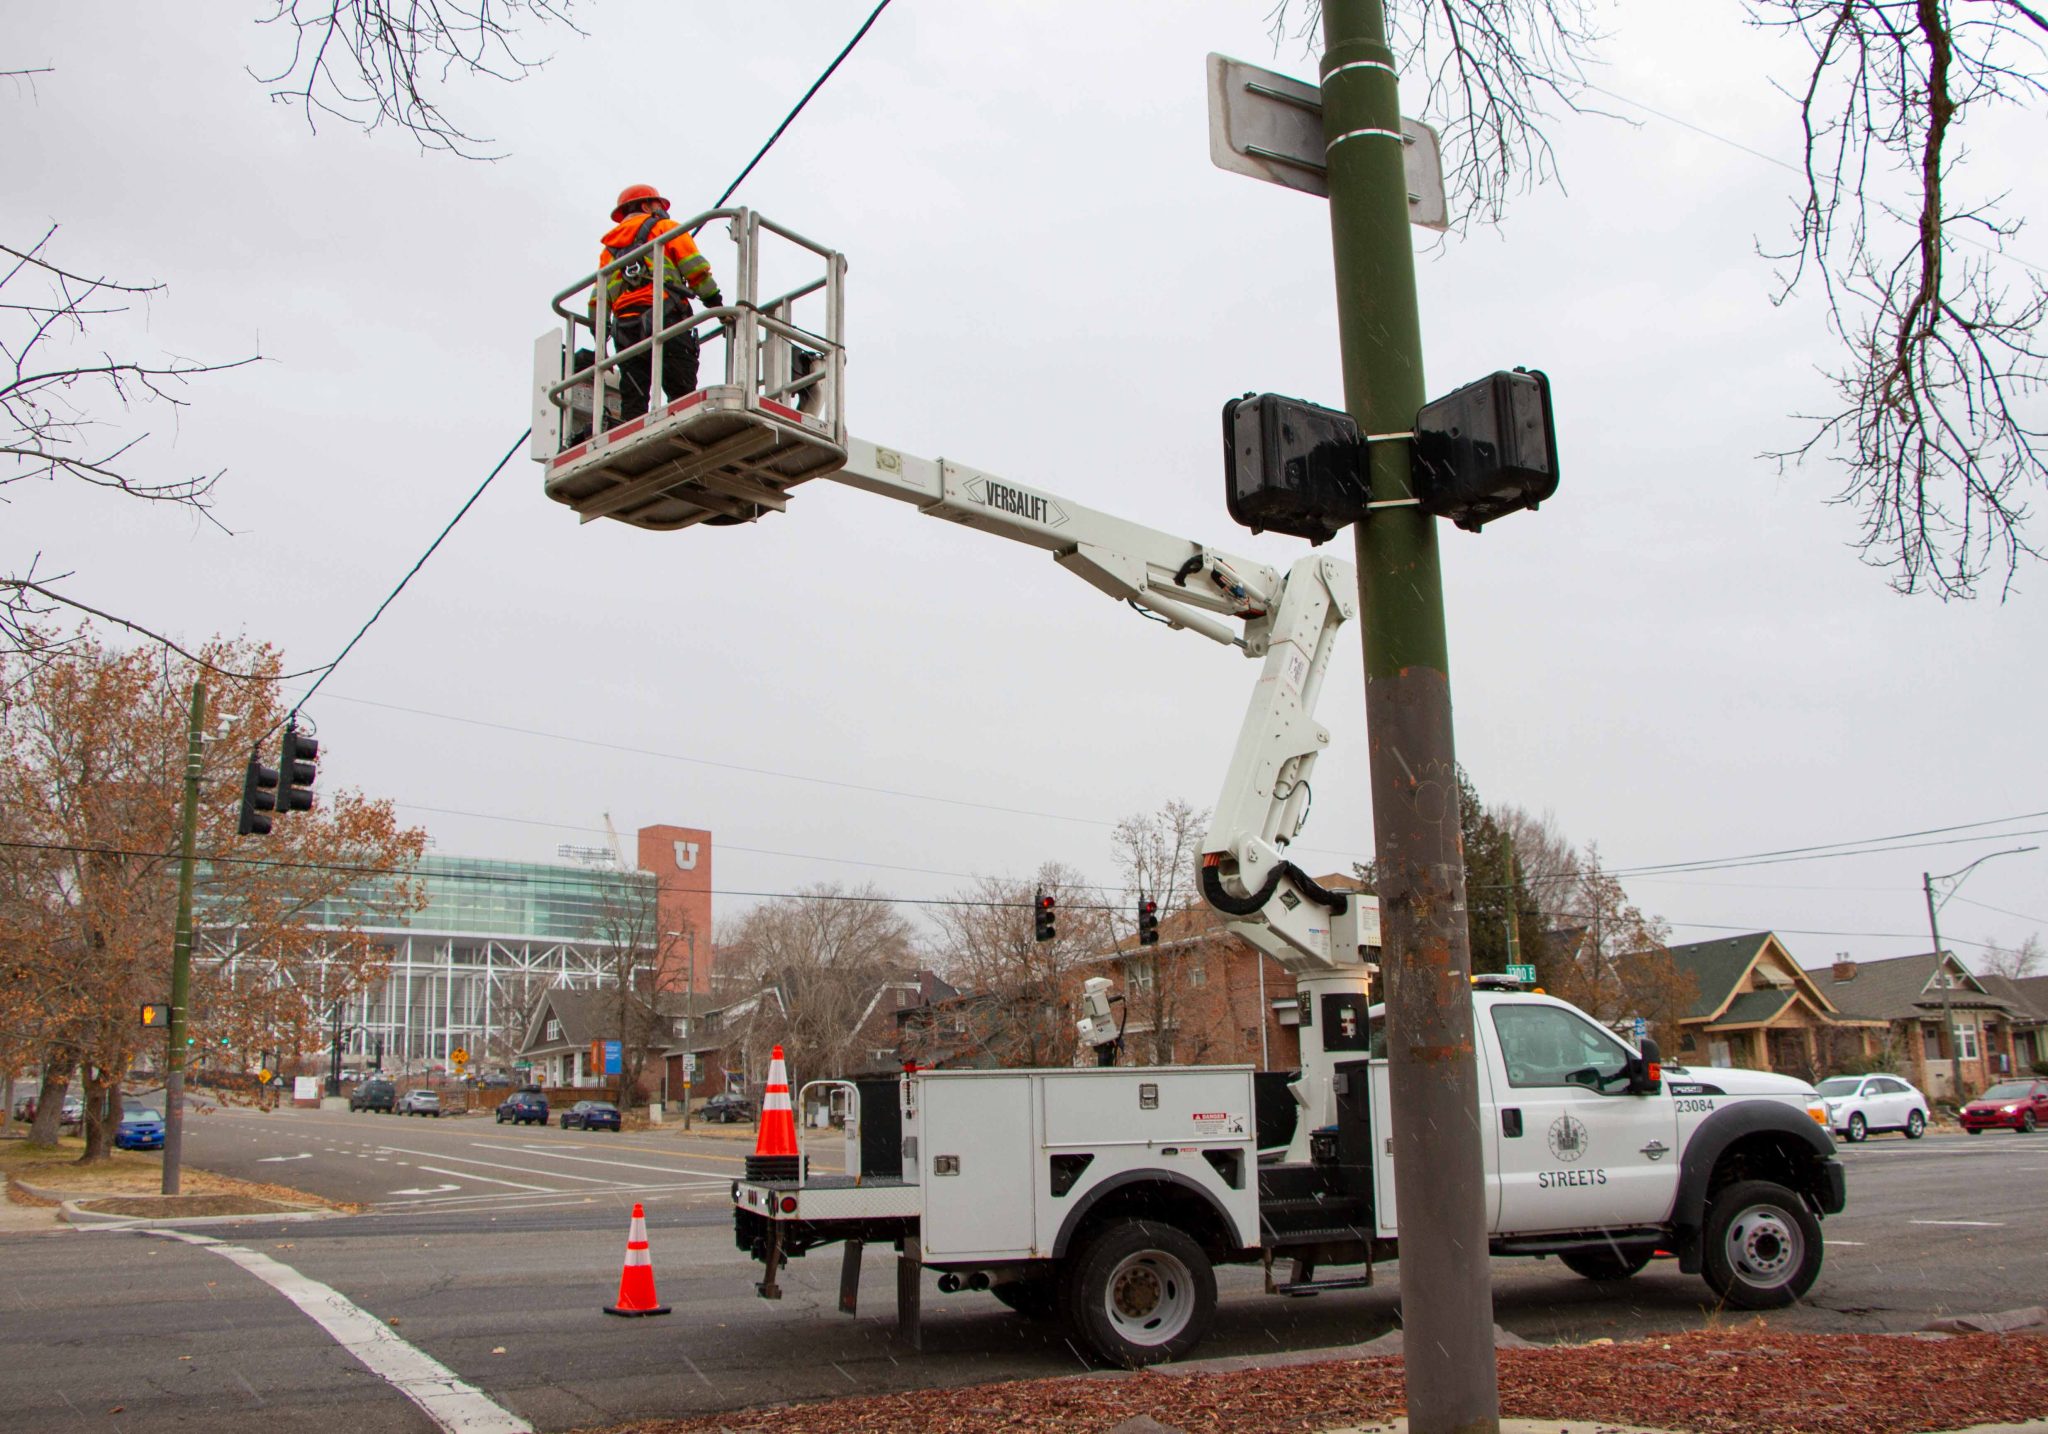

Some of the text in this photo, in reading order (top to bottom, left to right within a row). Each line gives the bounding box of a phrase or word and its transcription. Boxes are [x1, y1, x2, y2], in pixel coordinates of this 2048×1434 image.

[986, 480, 1048, 524] VERSALIFT
[673, 841, 699, 870] U
[1529, 967, 1535, 980] E
[1676, 1099, 1714, 1112] 23084
[1539, 1169, 1607, 1188] STREETS
